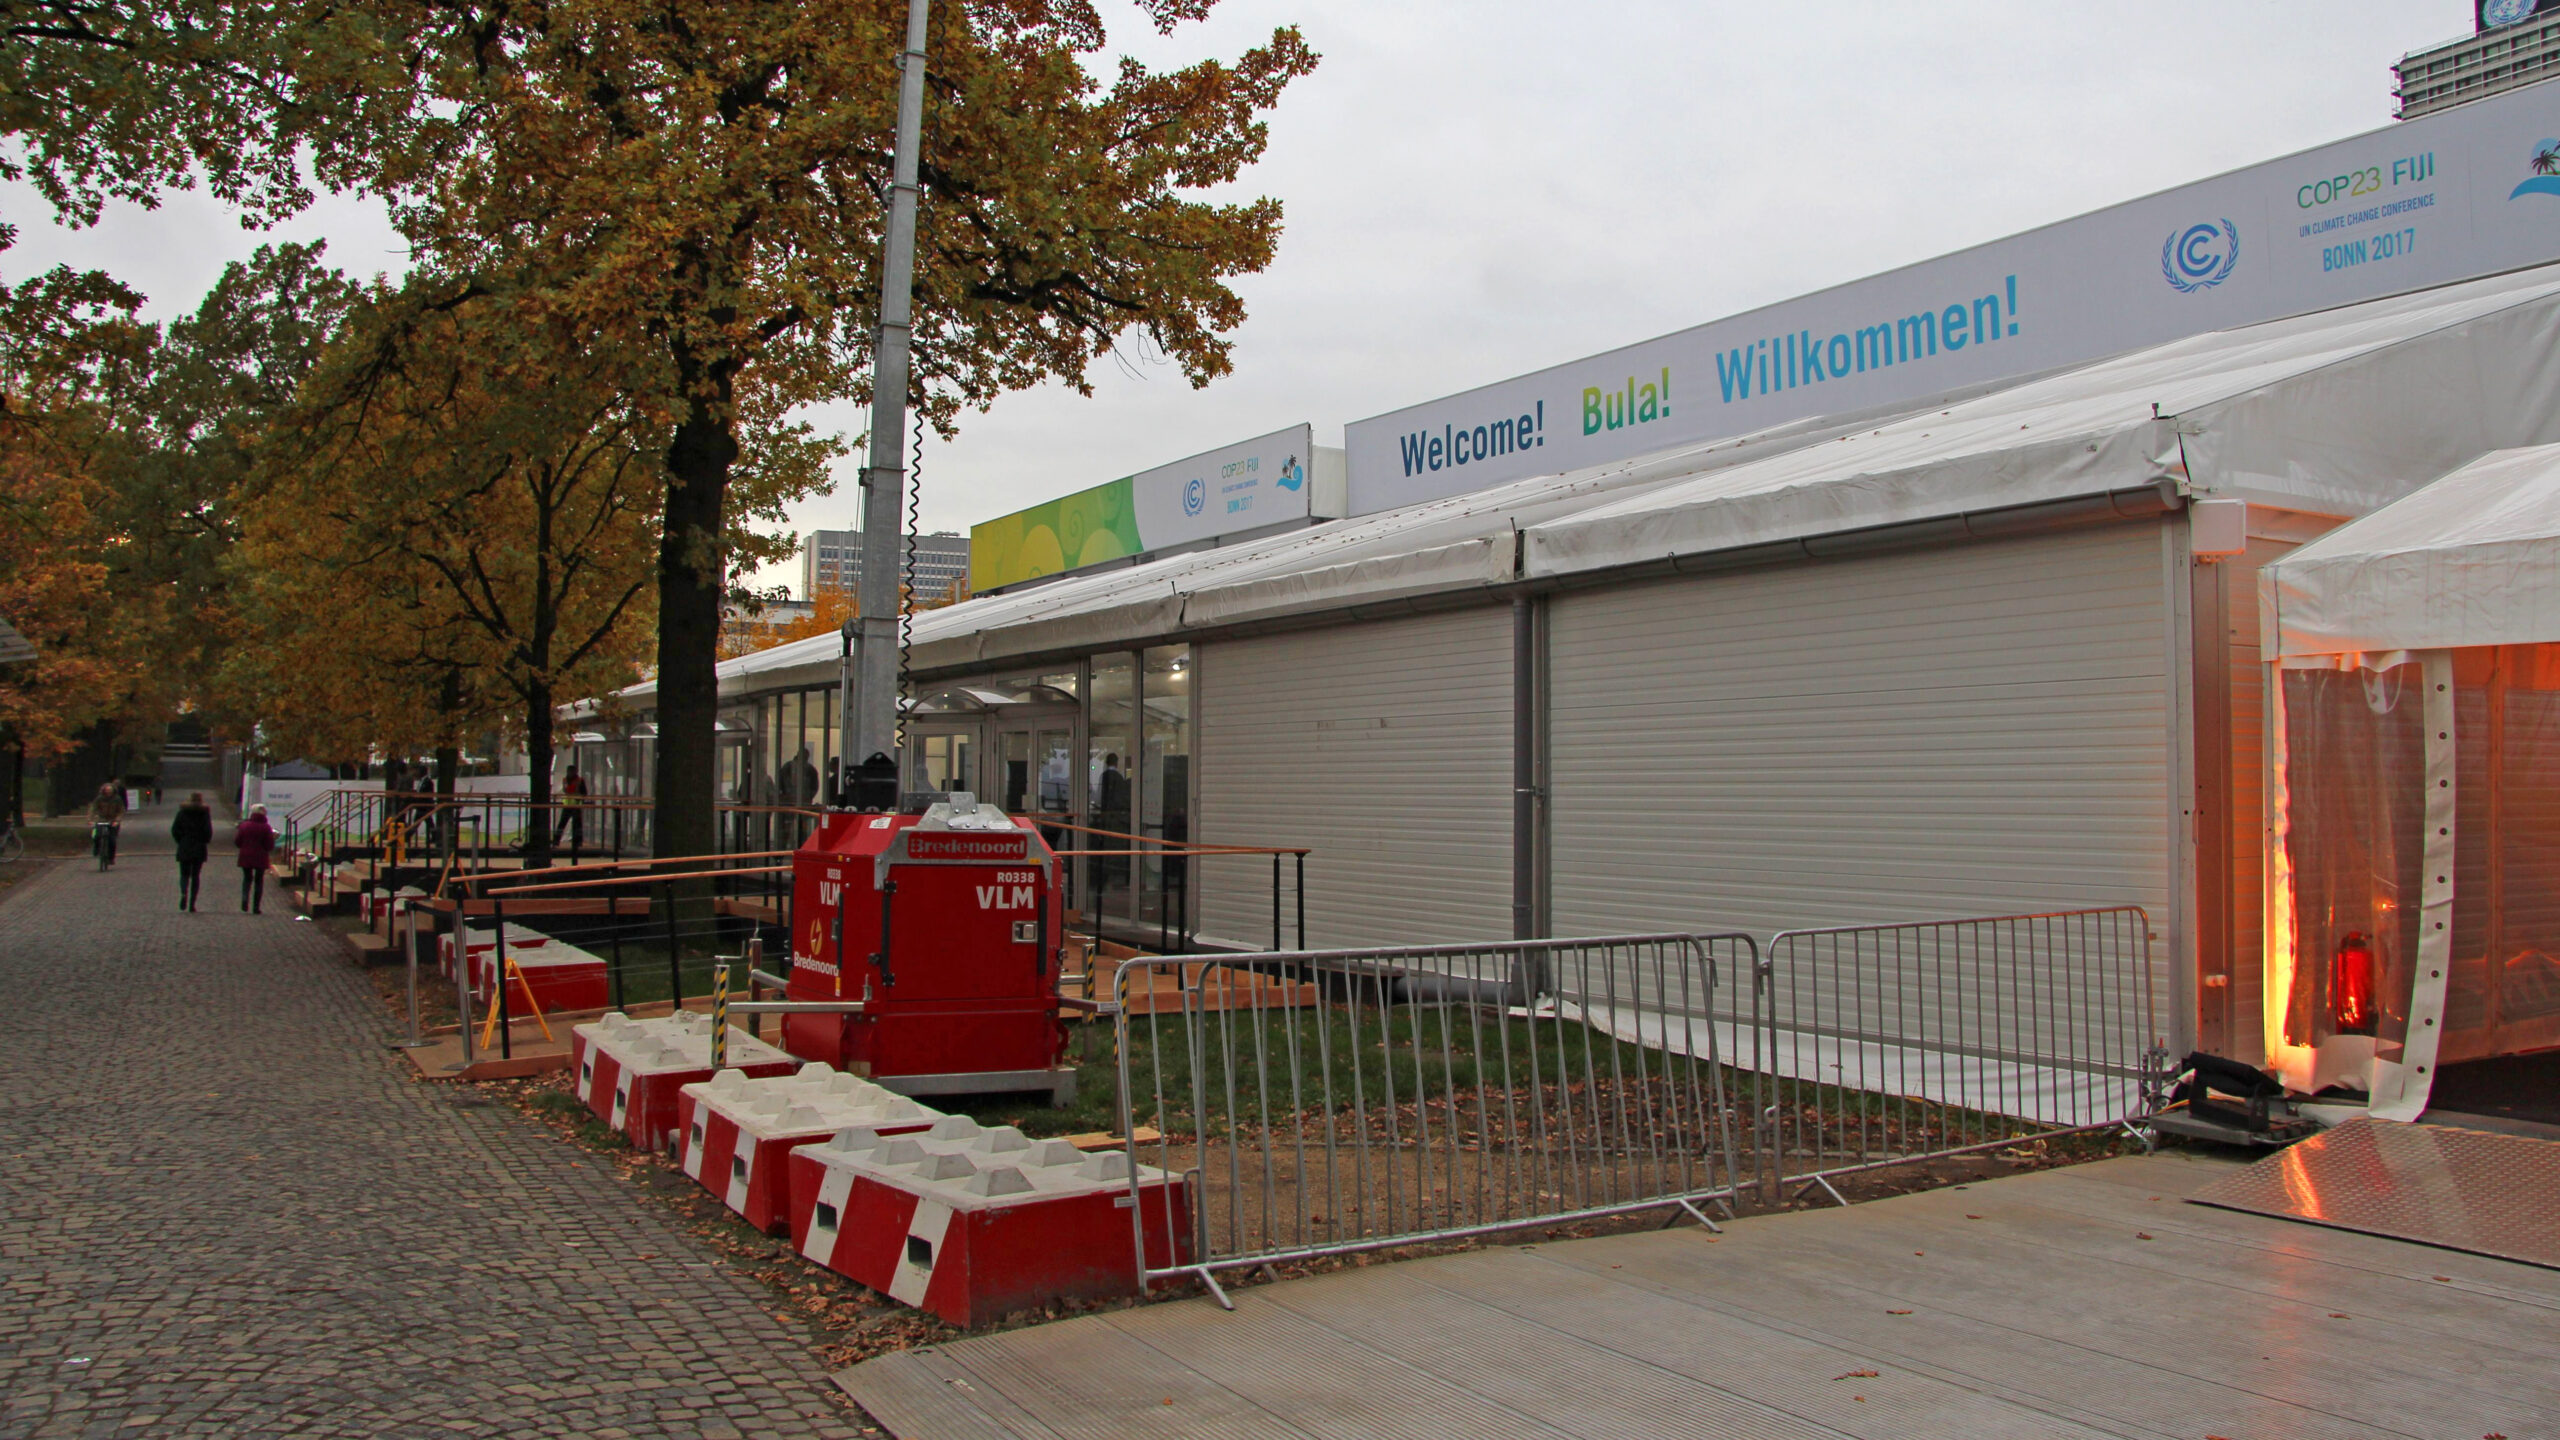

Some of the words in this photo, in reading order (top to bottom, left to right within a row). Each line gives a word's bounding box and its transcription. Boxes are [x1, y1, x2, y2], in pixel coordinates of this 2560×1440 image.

[2297, 166, 2382, 209] COP23
[2392, 151, 2435, 186] FIJI
[2299, 224, 2311, 238] UN
[2312, 215, 2346, 235] CLIMATE
[2347, 207, 2380, 226] CHANGE
[2381, 193, 2435, 218] CONFERENCE
[2323, 239, 2368, 272] BONN
[2371, 227, 2416, 262] 2017
[1401, 400, 1545, 477] Welcome!
[1582, 366, 1671, 437] Bula!
[1715, 274, 2020, 404] Willkommen!
[1221, 460, 1245, 479] COP23
[910, 838, 1025, 854] Bredenoord
[997, 871, 1035, 883] R0338
[820, 881, 840, 906] VLM
[976, 886, 1035, 910] VLM
